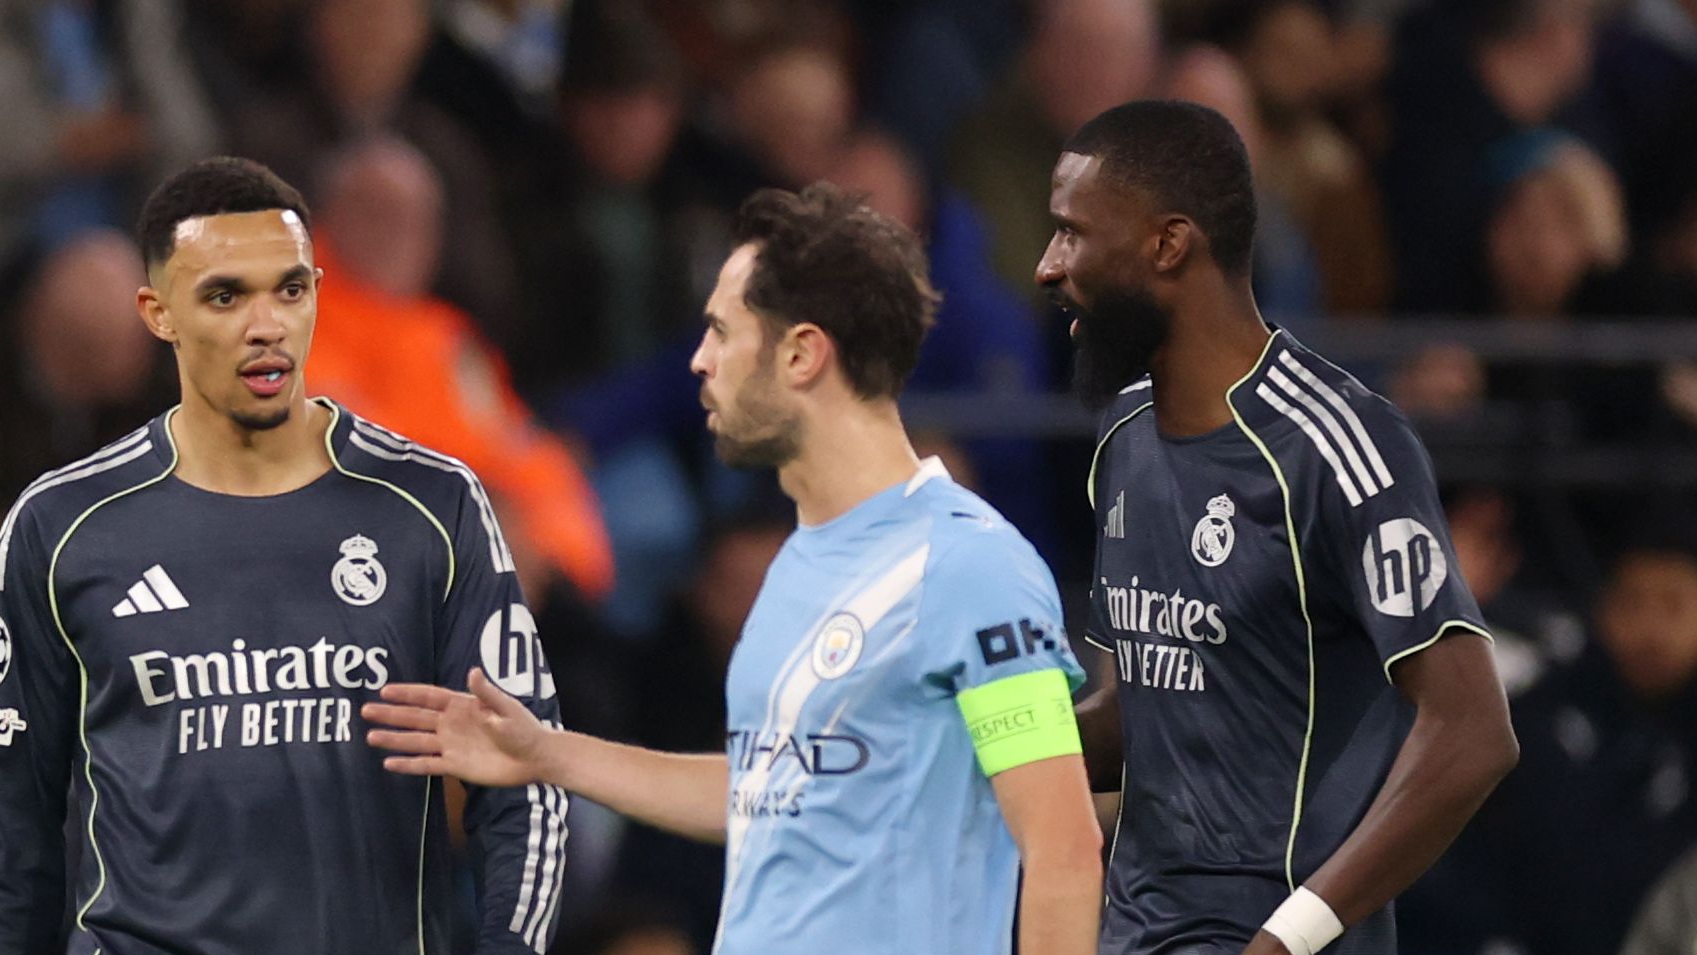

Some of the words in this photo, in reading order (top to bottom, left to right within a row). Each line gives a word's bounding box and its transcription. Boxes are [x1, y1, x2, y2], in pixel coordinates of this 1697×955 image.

[1369, 521, 1432, 615] hp
[1101, 575, 1227, 645] mirates
[129, 636, 389, 707] Emirates
[496, 603, 551, 699] hp
[178, 704, 229, 754] FLY
[241, 698, 352, 747] BETTER
[728, 728, 870, 775] TIHAD
[731, 789, 805, 817] RWAYS
